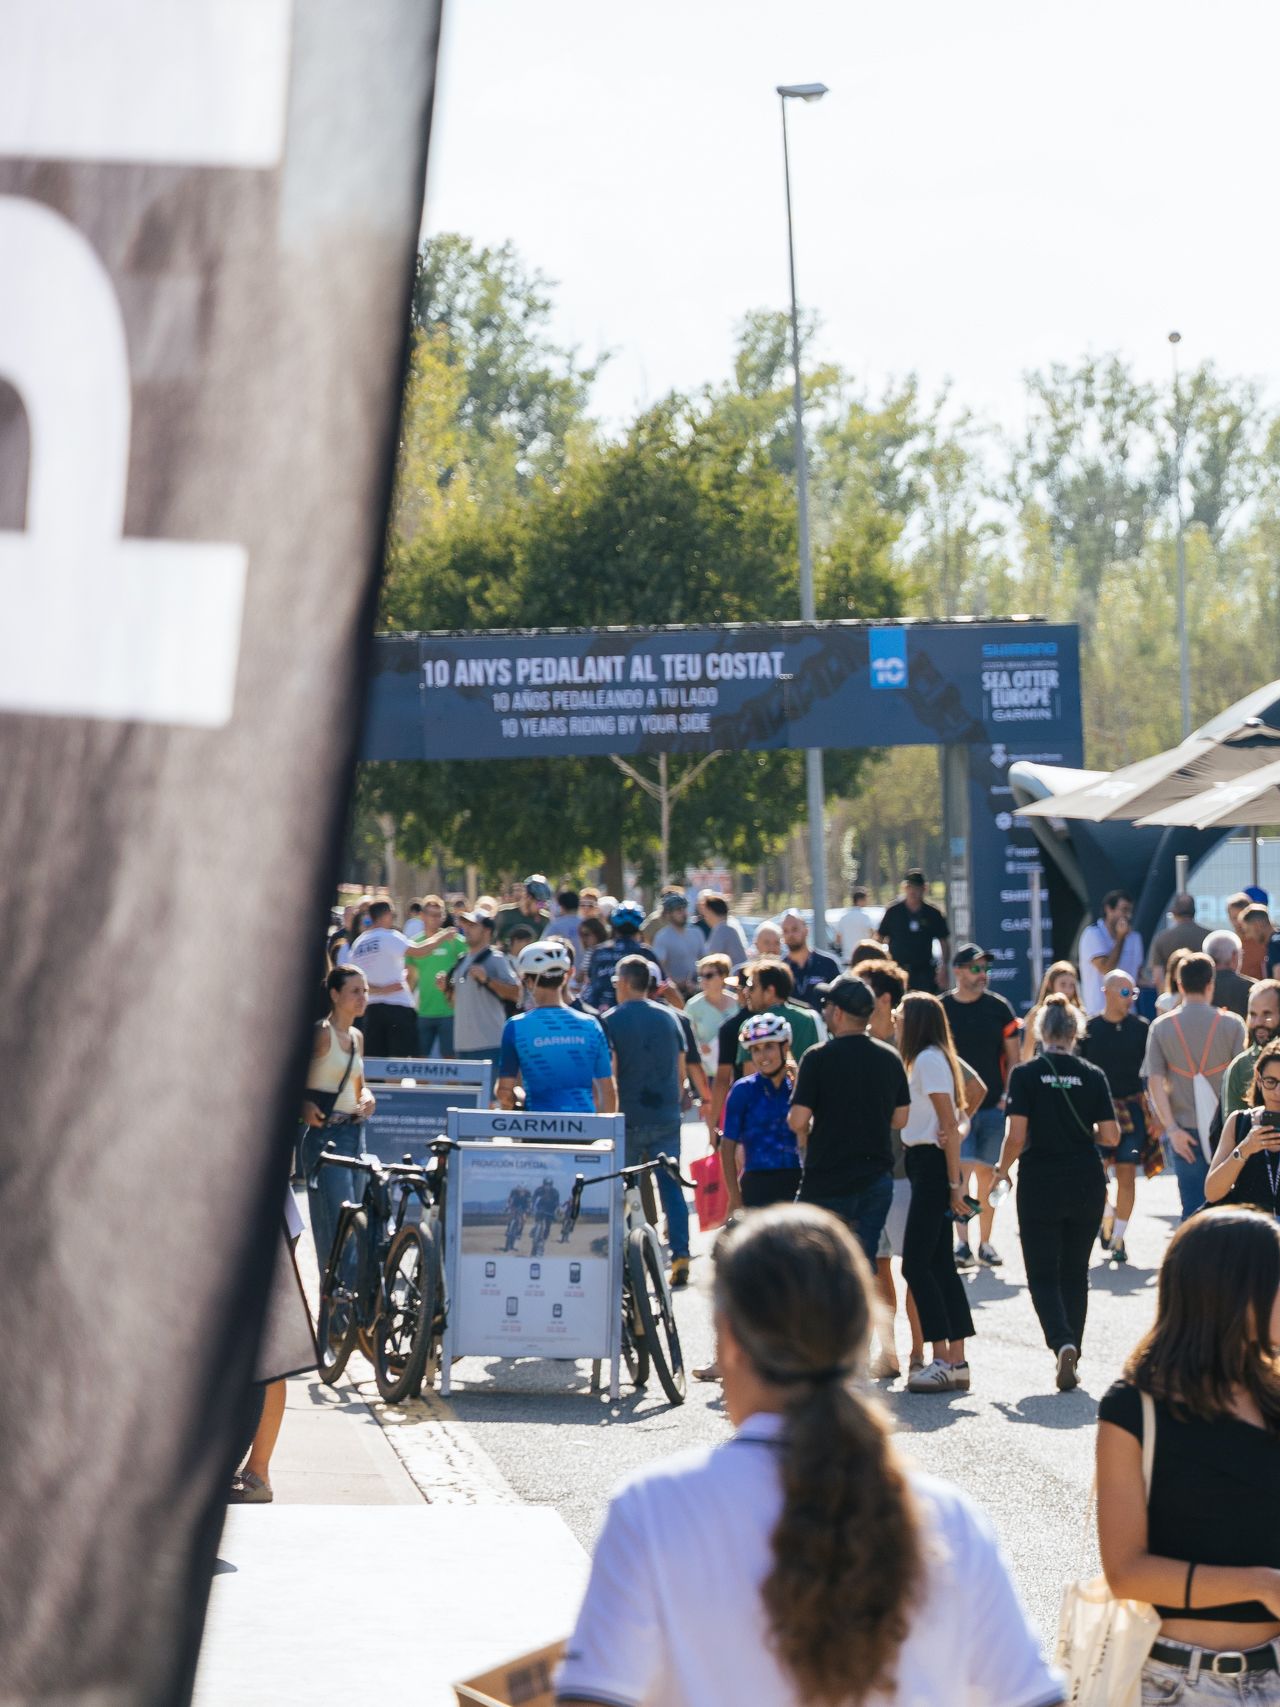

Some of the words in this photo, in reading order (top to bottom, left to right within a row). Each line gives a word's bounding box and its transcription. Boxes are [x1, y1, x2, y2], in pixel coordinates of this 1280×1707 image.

[422, 659, 449, 688] 10
[454, 657, 512, 687] ANYS
[516, 655, 625, 685] PEDALANT
[630, 654, 658, 682] AL
[661, 653, 701, 682] TEU
[706, 651, 784, 681] COSTAT
[493, 692, 510, 712] 10
[646, 689, 657, 708] A
[502, 718, 519, 738] 10
[520, 716, 568, 737] YEARS
[570, 714, 616, 736] RIDING
[618, 714, 637, 735] BY
[640, 713, 677, 734] YOUR
[679, 712, 711, 733] SIDE
[533, 1036, 585, 1048] GARMIN
[386, 1063, 458, 1077] GARMIN
[491, 1117, 584, 1133] GARMIN
